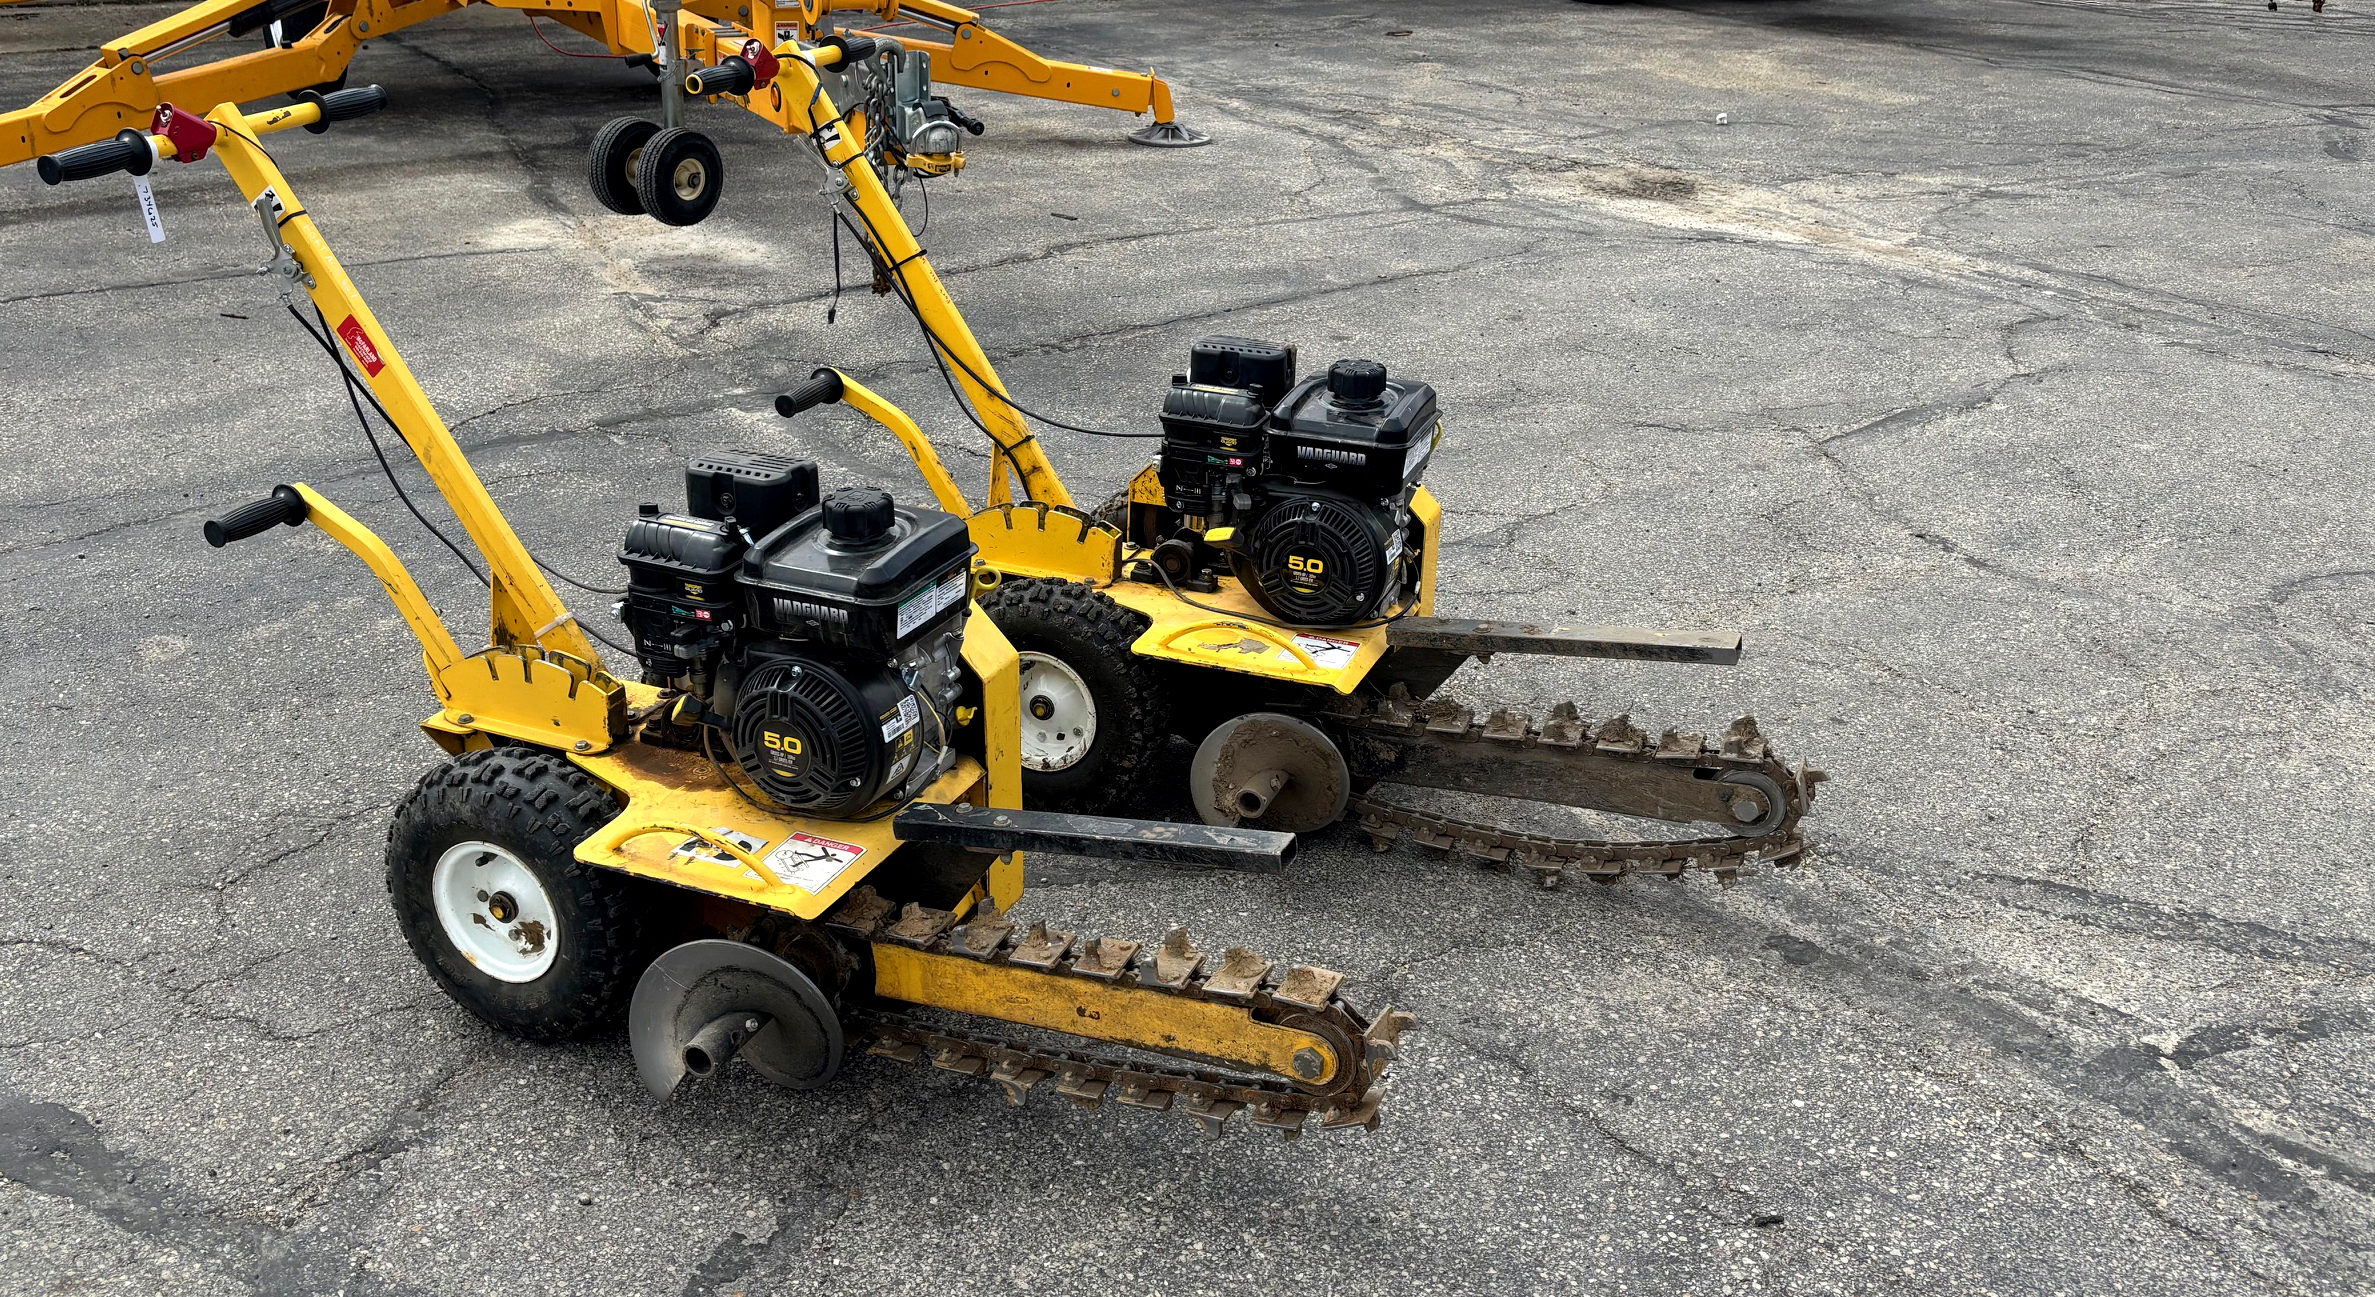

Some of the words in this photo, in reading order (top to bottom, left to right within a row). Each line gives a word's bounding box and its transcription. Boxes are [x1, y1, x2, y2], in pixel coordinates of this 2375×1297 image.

[1297, 445, 1366, 466] VANGUARD
[1288, 554, 1324, 574] 5.0
[773, 597, 849, 625] VANGUARD
[764, 730, 802, 755] 5.0
[812, 838, 850, 851] DANGER
